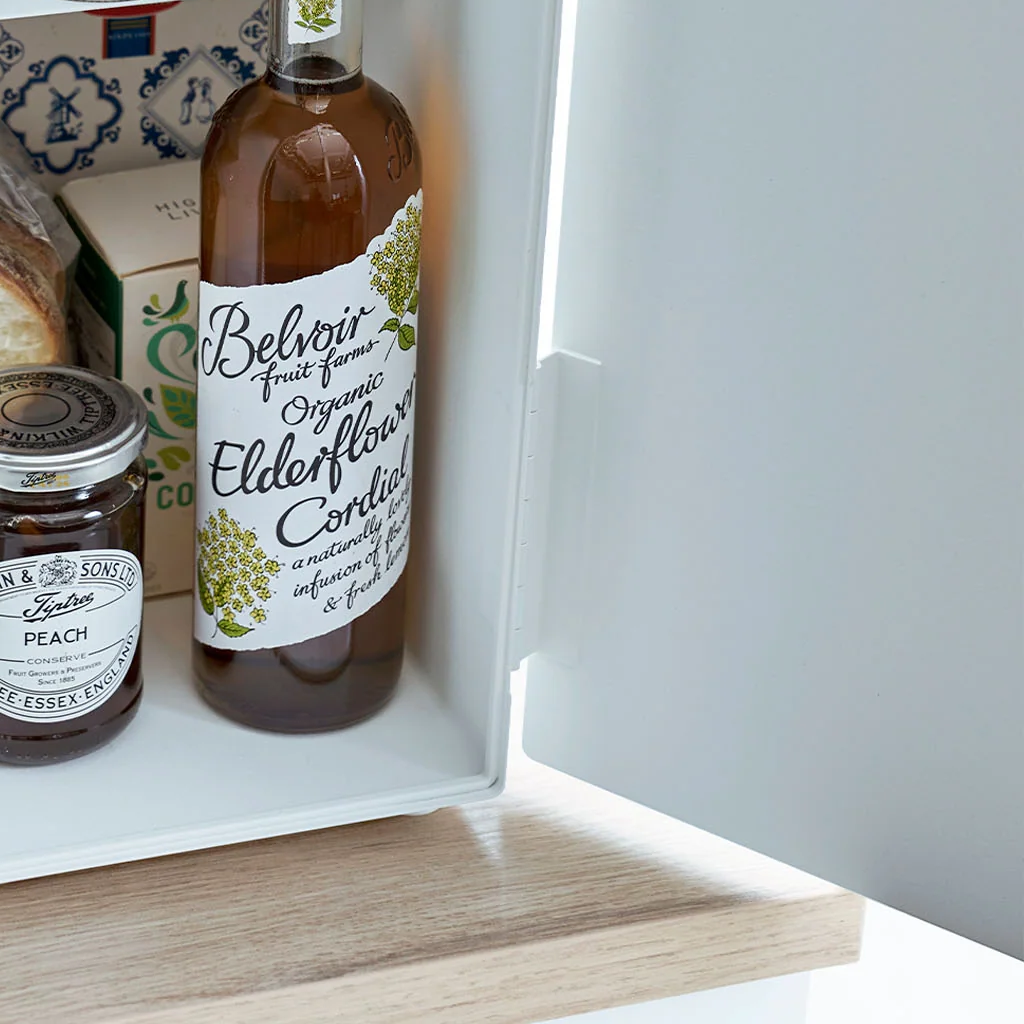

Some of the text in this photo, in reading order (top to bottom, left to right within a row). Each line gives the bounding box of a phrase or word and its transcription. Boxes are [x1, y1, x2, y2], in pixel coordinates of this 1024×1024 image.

[201, 301, 376, 378] Belvoir
[251, 339, 380, 403] fruit farms
[281, 372, 384, 435] Organic
[11, 426, 84, 442] WILKIN
[276, 433, 410, 548] Cordial
[21, 569, 33, 583] &
[81, 562, 120, 578] SONS
[293, 559, 363, 600] infusion
[23, 591, 94, 623] Tiptree
[323, 596, 343, 613] &
[24, 626, 88, 647] PEACH
[27, 652, 87, 665] CONSERVE
